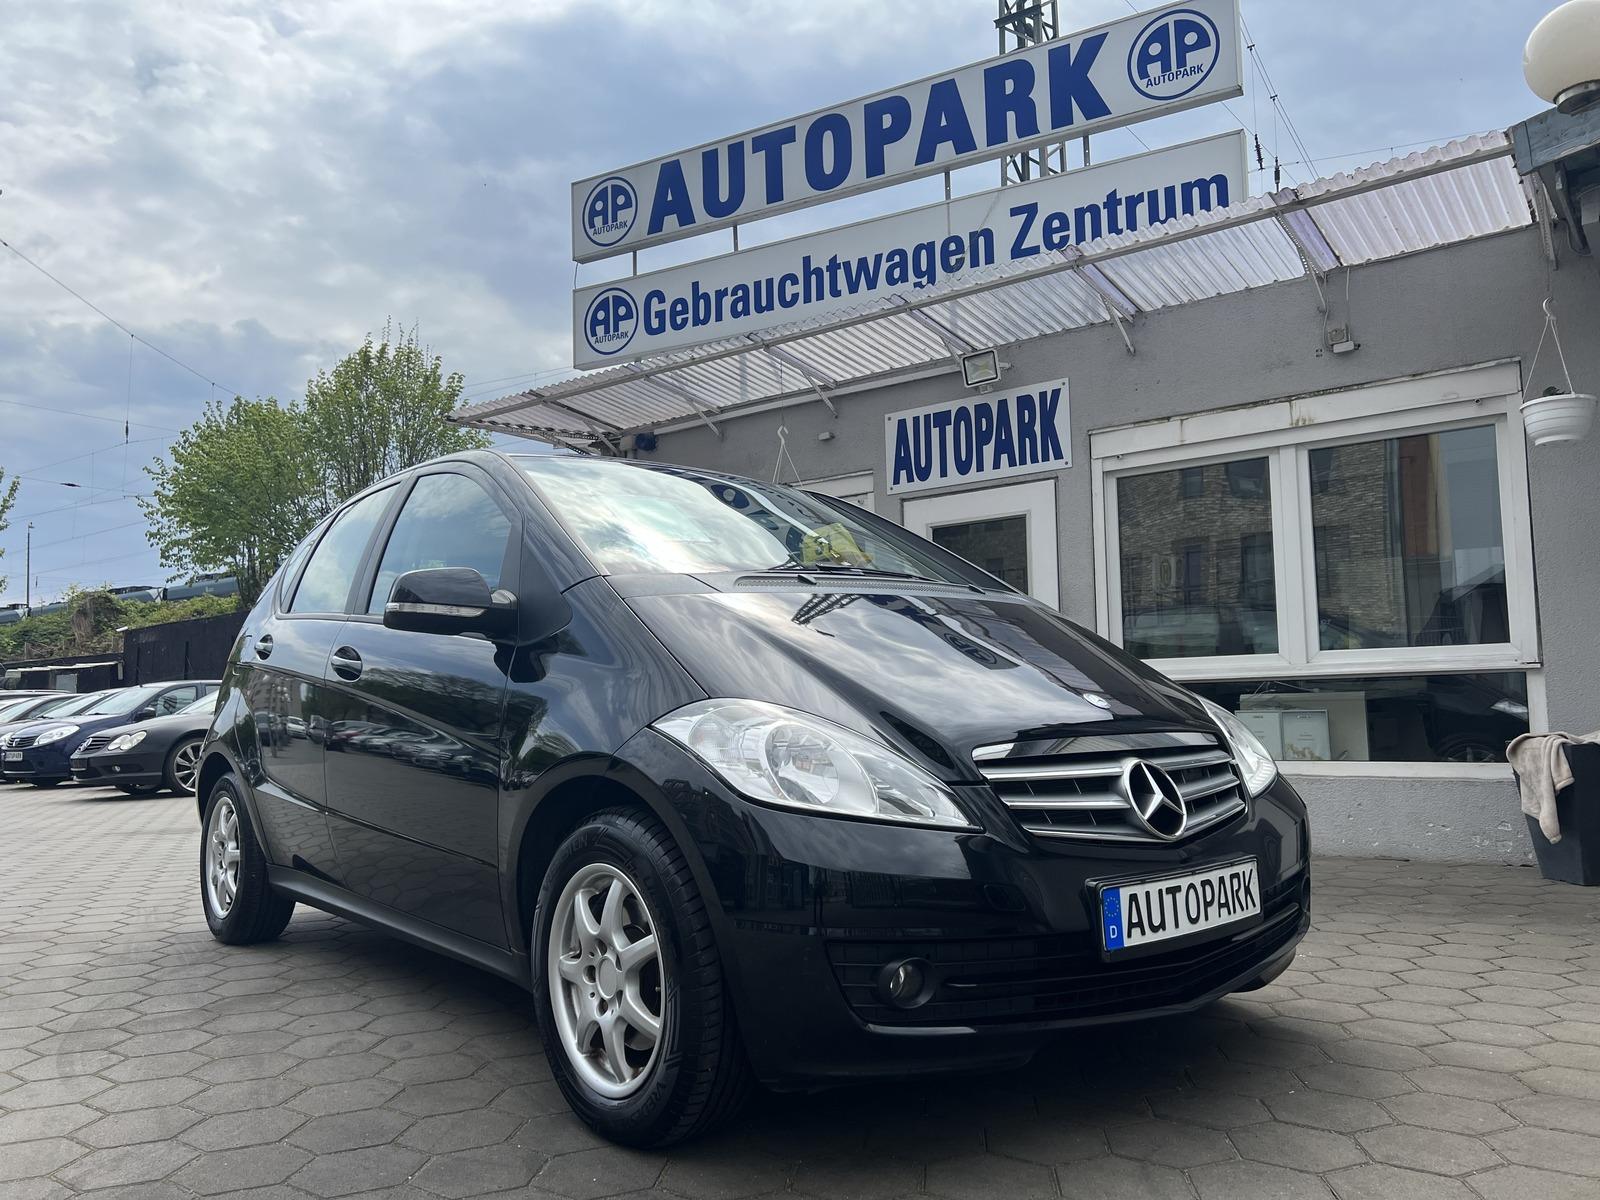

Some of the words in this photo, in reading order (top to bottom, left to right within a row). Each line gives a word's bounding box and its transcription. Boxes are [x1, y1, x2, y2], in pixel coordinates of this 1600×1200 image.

[1136, 19, 1211, 80] AP
[1145, 64, 1204, 88] AUTOPARK
[647, 32, 1112, 236] AUTOPARK
[588, 184, 633, 229] AP
[592, 219, 628, 236] AUTOPARK
[643, 227, 995, 336] Gebrauchtwagen
[1009, 173, 1230, 260] Zentrum
[590, 295, 634, 337] AP
[594, 330, 629, 345] AUTOPARK
[893, 388, 1064, 485] AUTOPARK
[1109, 925, 1118, 939] D
[1127, 868, 1257, 939] AUTOPARK
